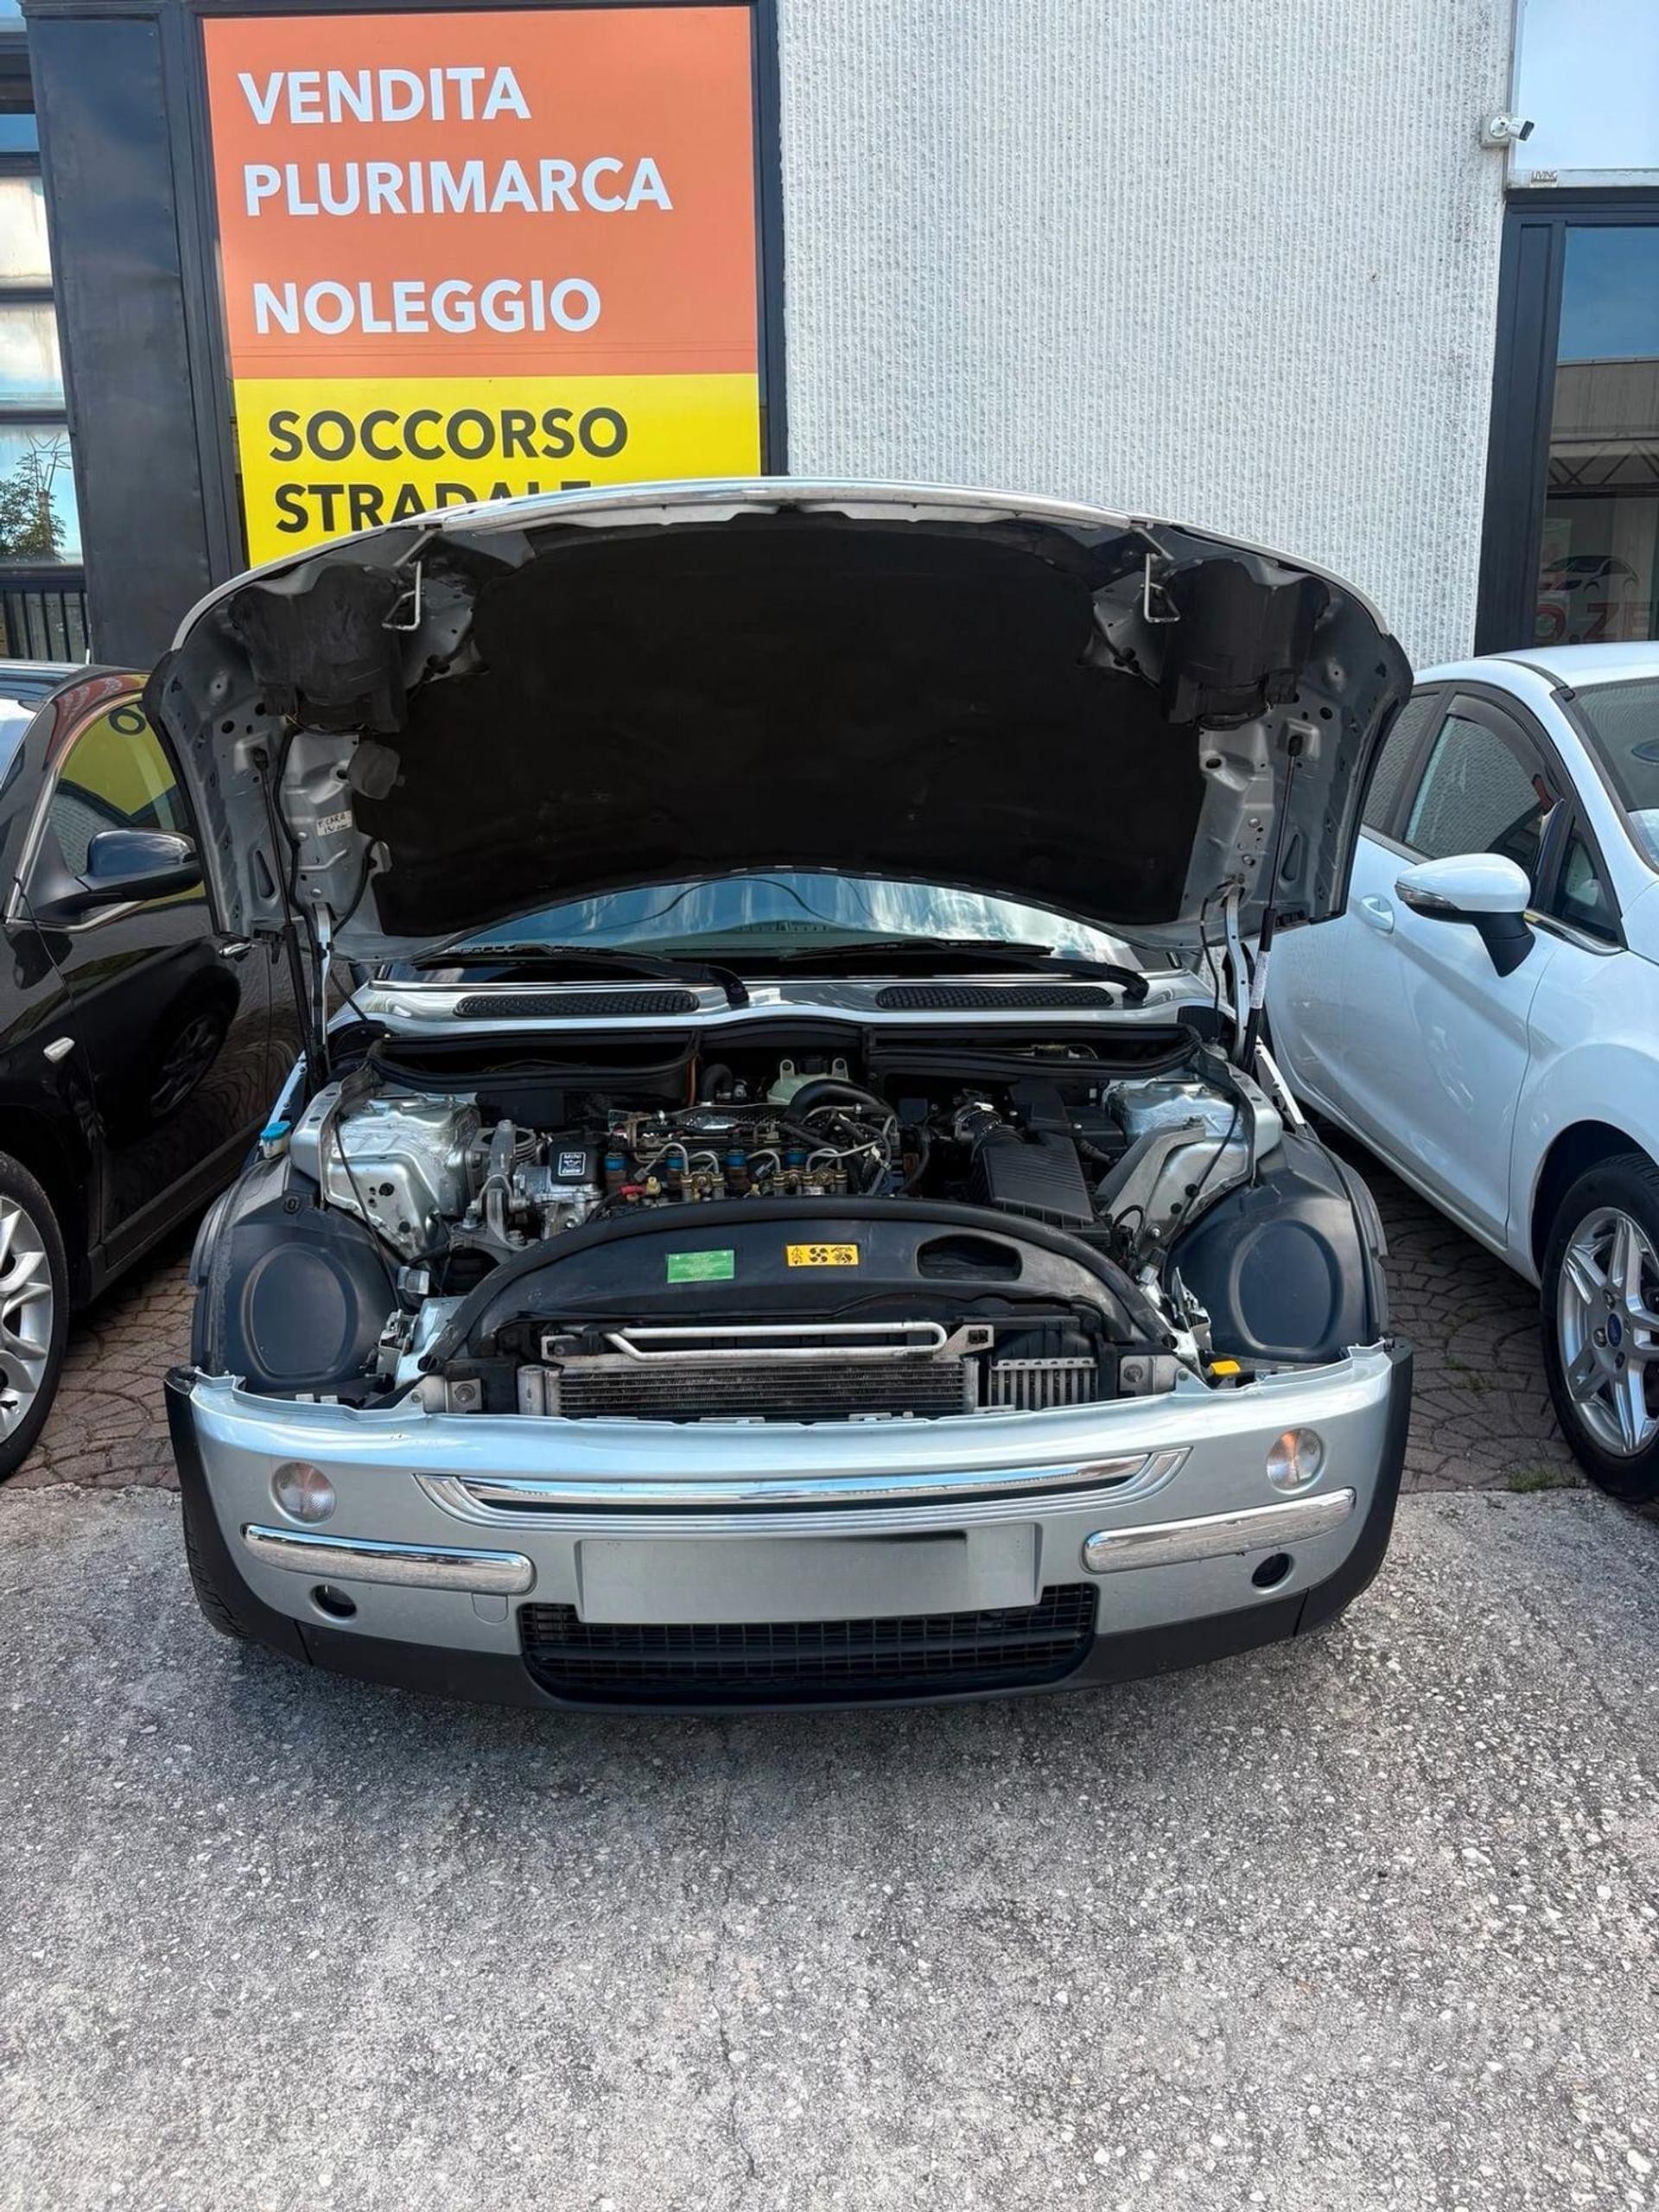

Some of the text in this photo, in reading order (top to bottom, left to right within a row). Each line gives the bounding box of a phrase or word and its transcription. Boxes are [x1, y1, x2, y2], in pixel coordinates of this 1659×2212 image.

[238, 67, 531, 124] VENDITA
[245, 157, 672, 215] PLURIMARCA
[254, 279, 600, 334] NOLEGGIO
[270, 408, 627, 461] SOCCORSO
